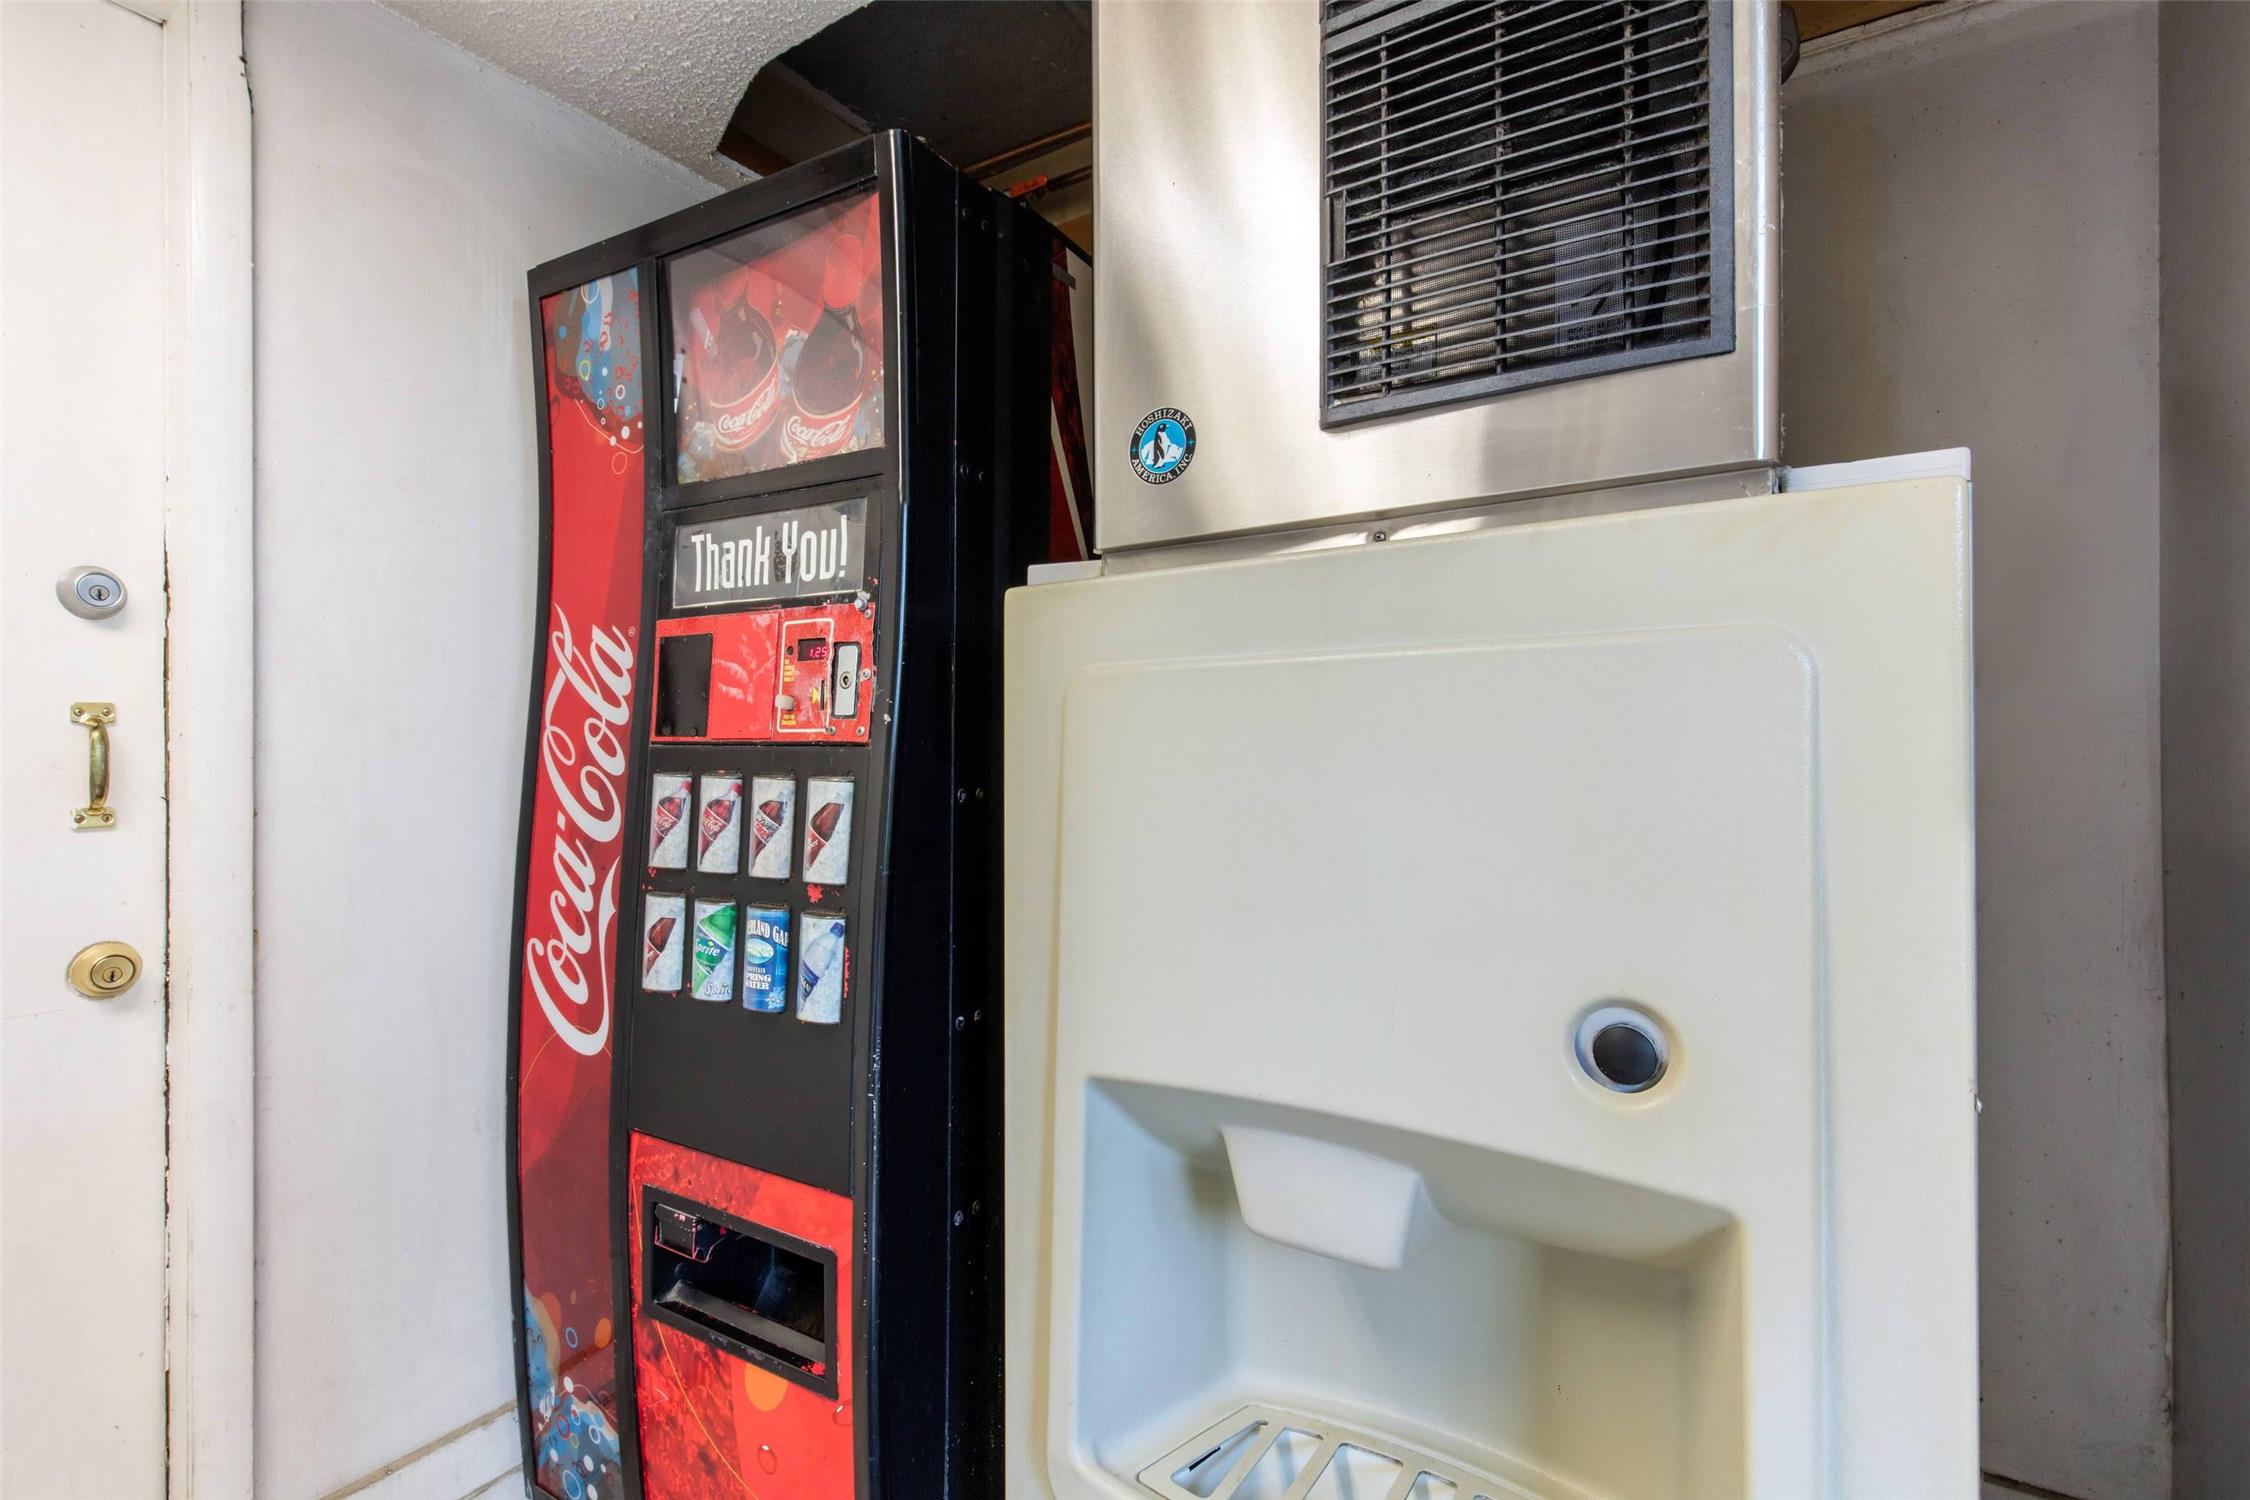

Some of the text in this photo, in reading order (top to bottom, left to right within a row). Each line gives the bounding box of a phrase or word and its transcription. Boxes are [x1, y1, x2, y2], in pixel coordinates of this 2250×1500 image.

[1135, 409, 1193, 436] HOSHIZAKI
[690, 525, 771, 593] Thank
[526, 601, 635, 1057] Coca-Cola
